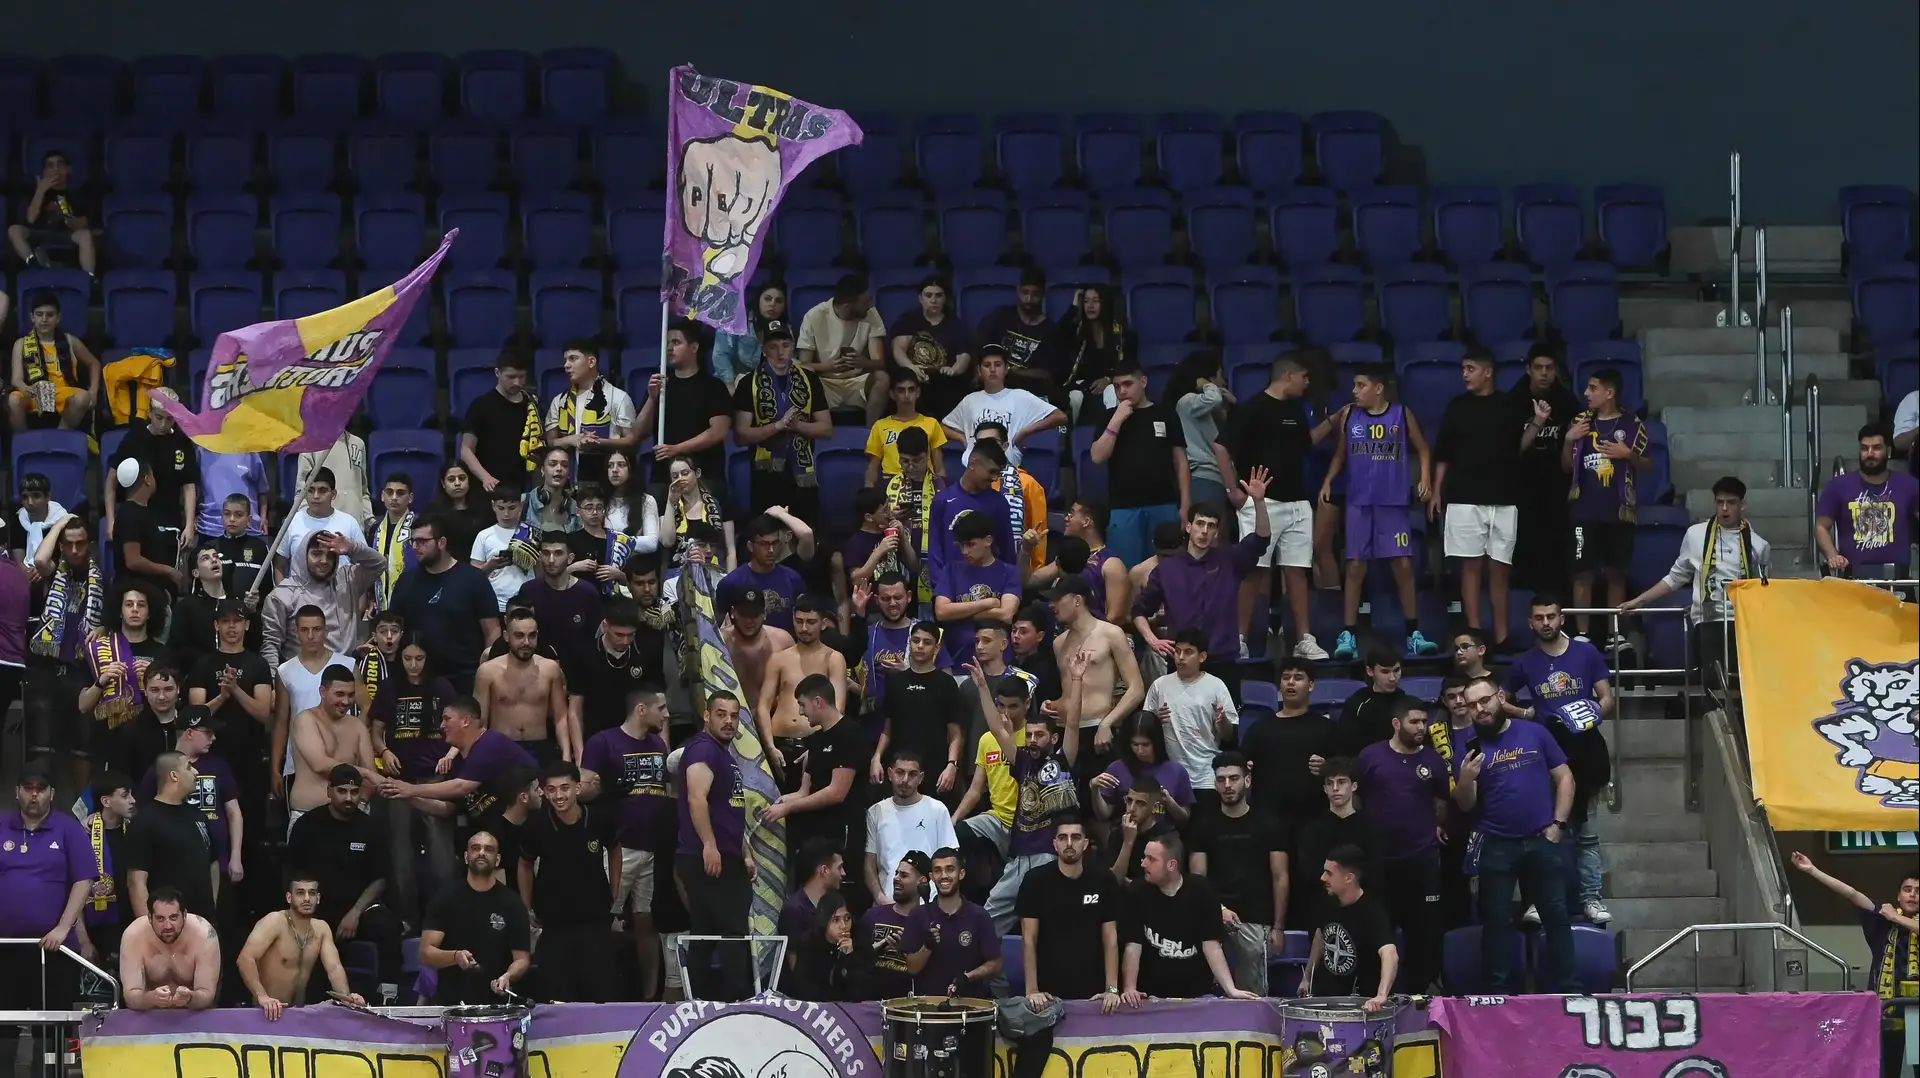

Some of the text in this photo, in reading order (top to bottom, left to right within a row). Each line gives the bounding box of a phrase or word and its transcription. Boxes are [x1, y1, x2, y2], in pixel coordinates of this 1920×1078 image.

[680, 72, 832, 141] ULTRAS
[1369, 424, 1384, 439] 10
[351, 444, 364, 469] LA
[1394, 532, 1409, 548] 10
[1487, 747, 1532, 768] Holonia
[1083, 894, 1099, 905] D2
[1338, 928, 1354, 954] ISLAND
[1337, 956, 1354, 974] STONE
[1563, 997, 1699, 1050] כבוד
